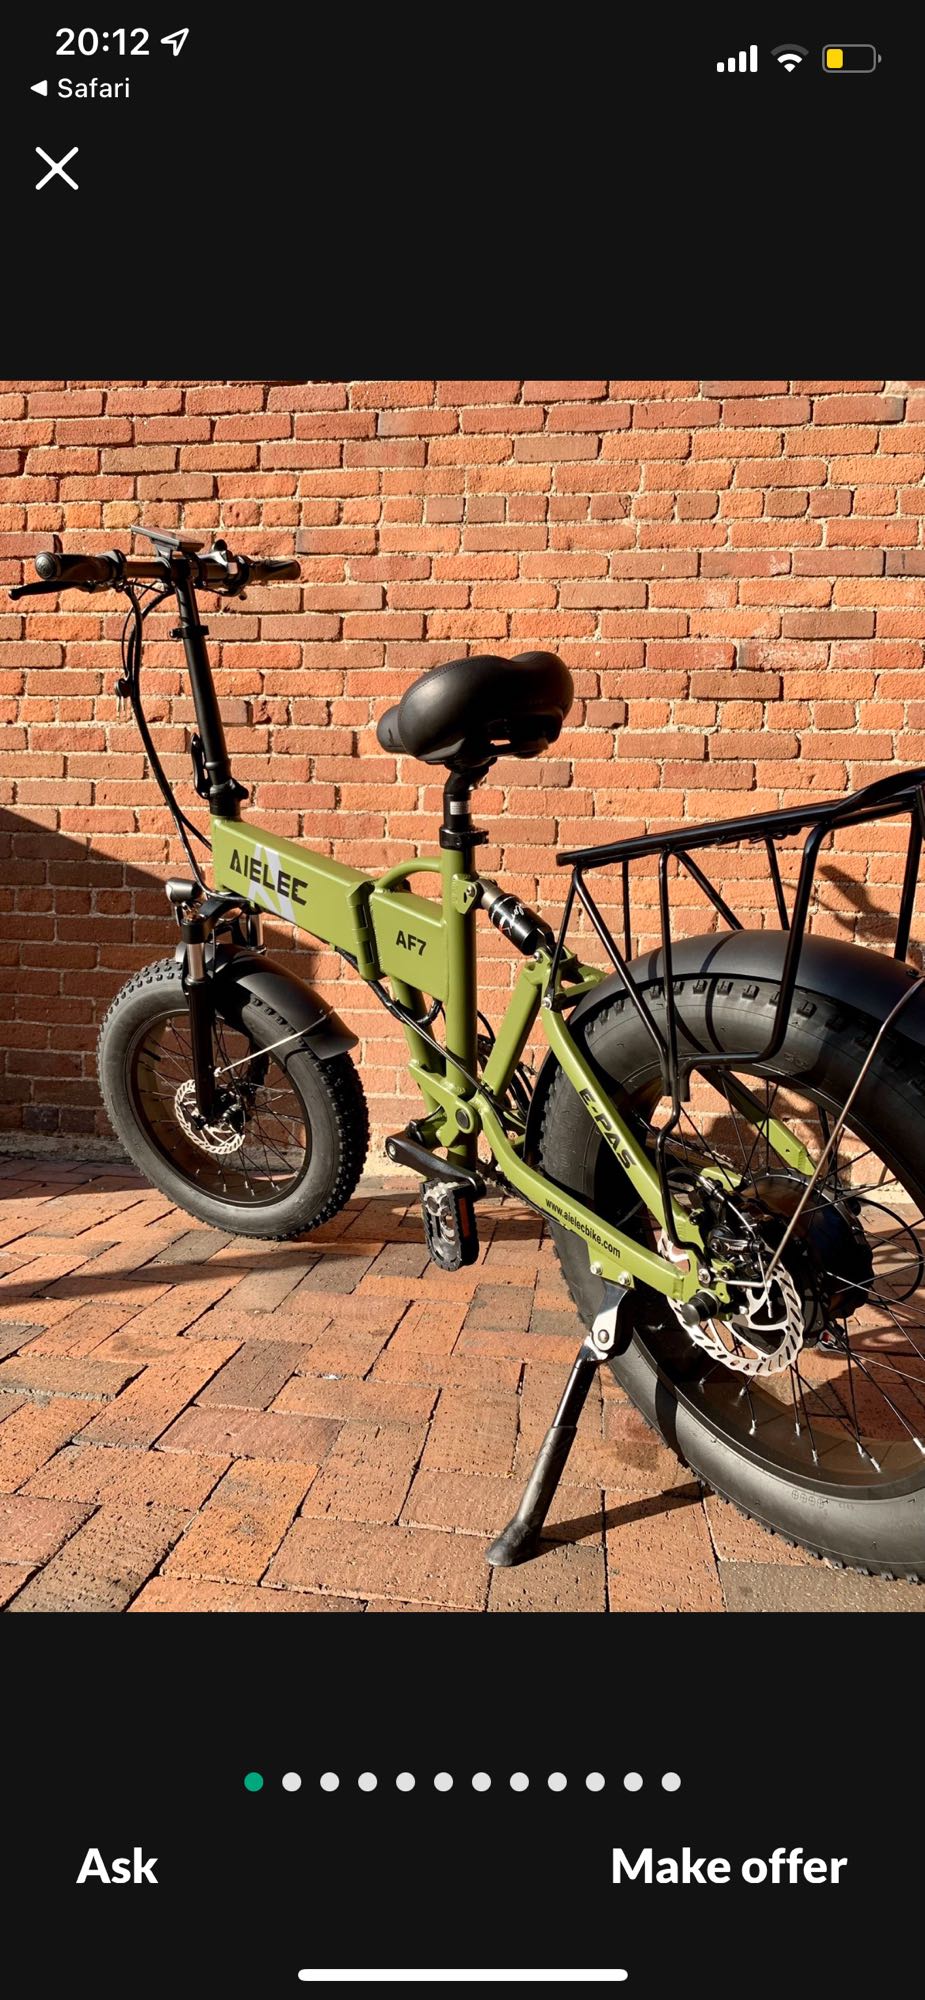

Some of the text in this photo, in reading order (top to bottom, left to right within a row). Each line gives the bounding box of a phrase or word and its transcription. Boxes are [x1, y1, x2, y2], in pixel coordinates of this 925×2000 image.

[229, 849, 309, 906] AIELEC
[395, 930, 427, 956] AF7
[578, 1088, 637, 1169] E-PAS
[545, 1198, 621, 1259] www.aielecbike.com
